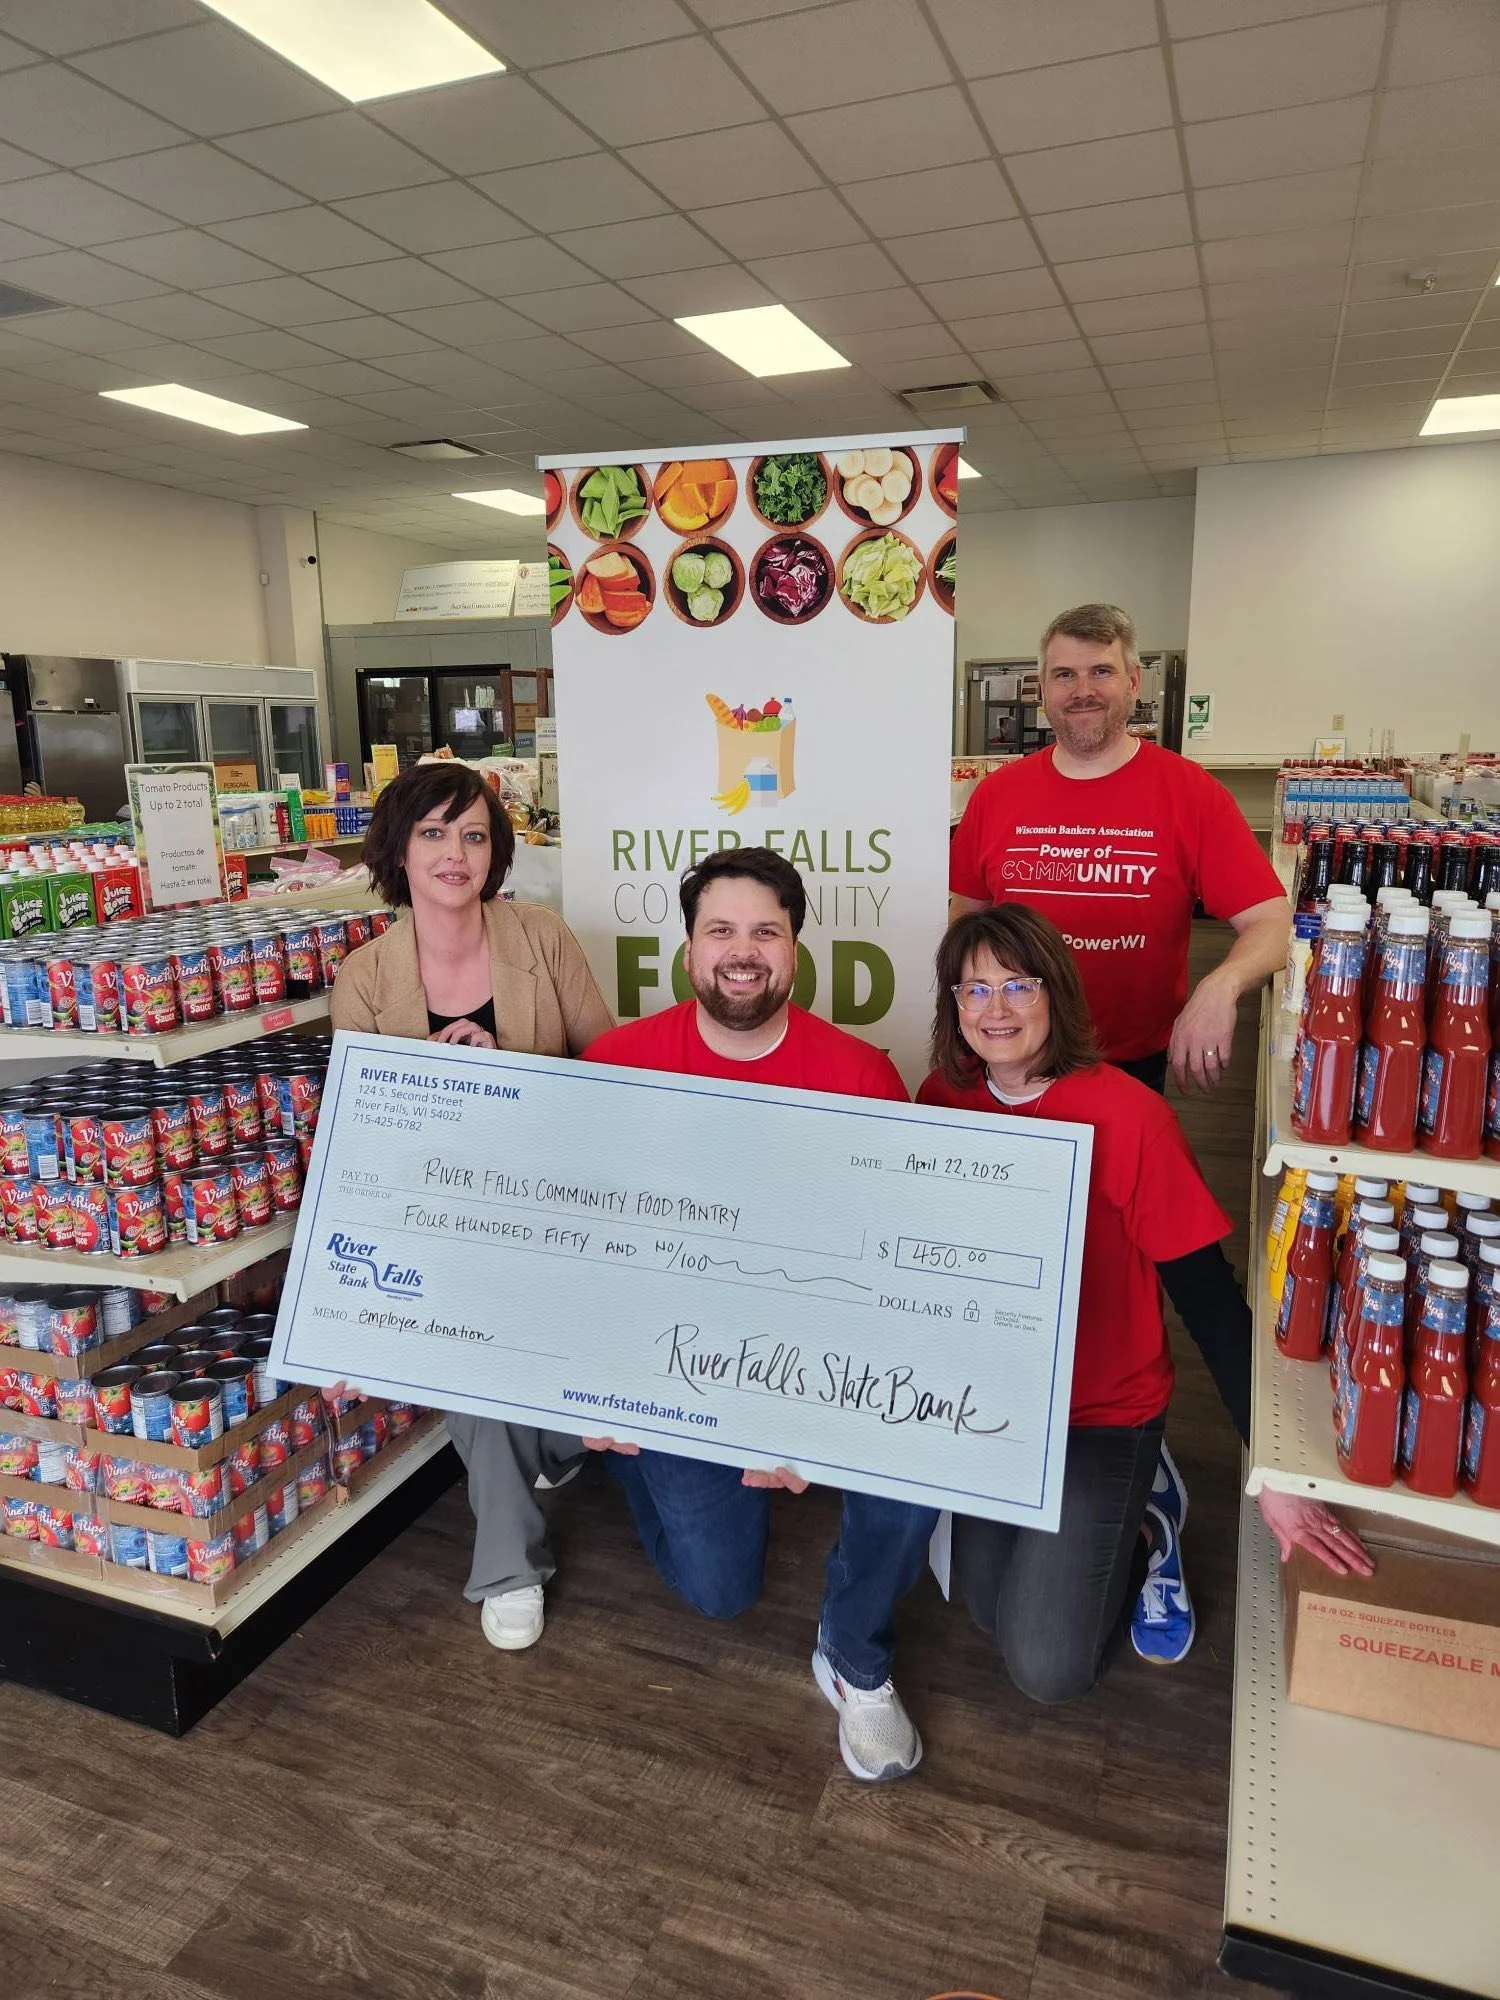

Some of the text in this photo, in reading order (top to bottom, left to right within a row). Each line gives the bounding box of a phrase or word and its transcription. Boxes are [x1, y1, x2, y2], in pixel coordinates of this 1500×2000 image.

[141, 782, 208, 793] Tomato Products
[150, 802, 162, 812] Up
[176, 800, 182, 808] 2
[184, 799, 203, 808] total
[1015, 825, 1154, 838] Wisconsin Bankers Association
[161, 849, 195, 858] Productos
[1040, 844, 1112, 858] Power of
[161, 881, 180, 889] Hasta
[614, 883, 891, 927] CONITY
[131, 972, 163, 990] Vine
[616, 936, 895, 1025] FD
[190, 1003, 211, 1013] Sauce
[155, 1012, 175, 1024] Sauce
[360, 1067, 521, 1100] RIVER FALLS STATE BANK
[358, 1085, 464, 1108] 124 S. Second Street
[355, 1099, 462, 1122] River Falls, WI 54022
[352, 1113, 422, 1132] 715-425-6782
[12, 1159, 28, 1169] Sau
[850, 1156, 882, 1169] DATE
[905, 1153, 936, 1174] April
[133, 1168, 153, 1179] Sauce
[341, 1169, 379, 1183] PAY TO
[338, 1185, 392, 1199] THE ORDER OF
[423, 1157, 740, 1231] RIVER FALLS COMMUNITY FOOD PANTRY
[75, 1196, 103, 1213] Ripe
[404, 1205, 449, 1228] FOUR
[455, 1215, 532, 1240] HUNDRED
[545, 1228, 590, 1253] FIFTY
[605, 1241, 637, 1257] AND
[326, 1232, 377, 1256] River
[878, 1241, 889, 1259] $
[328, 1260, 357, 1274] State
[381, 1263, 423, 1287] Falls
[339, 1274, 369, 1288] Bank
[312, 1306, 348, 1321] MEMO
[878, 1295, 953, 1318] DOLLARS
[358, 1309, 494, 1342] employee donation
[819, 1352, 882, 1410] State
[881, 1366, 1010, 1435] Bank
[562, 1386, 719, 1428] www.rfstatebank.com
[1339, 1609, 1357, 1618] OZ.
[1359, 1612, 1406, 1628] SQUEEZE
[1409, 1622, 1457, 1638] BOTTLES
[1339, 1633, 1484, 1673] SQUEEZABLE
